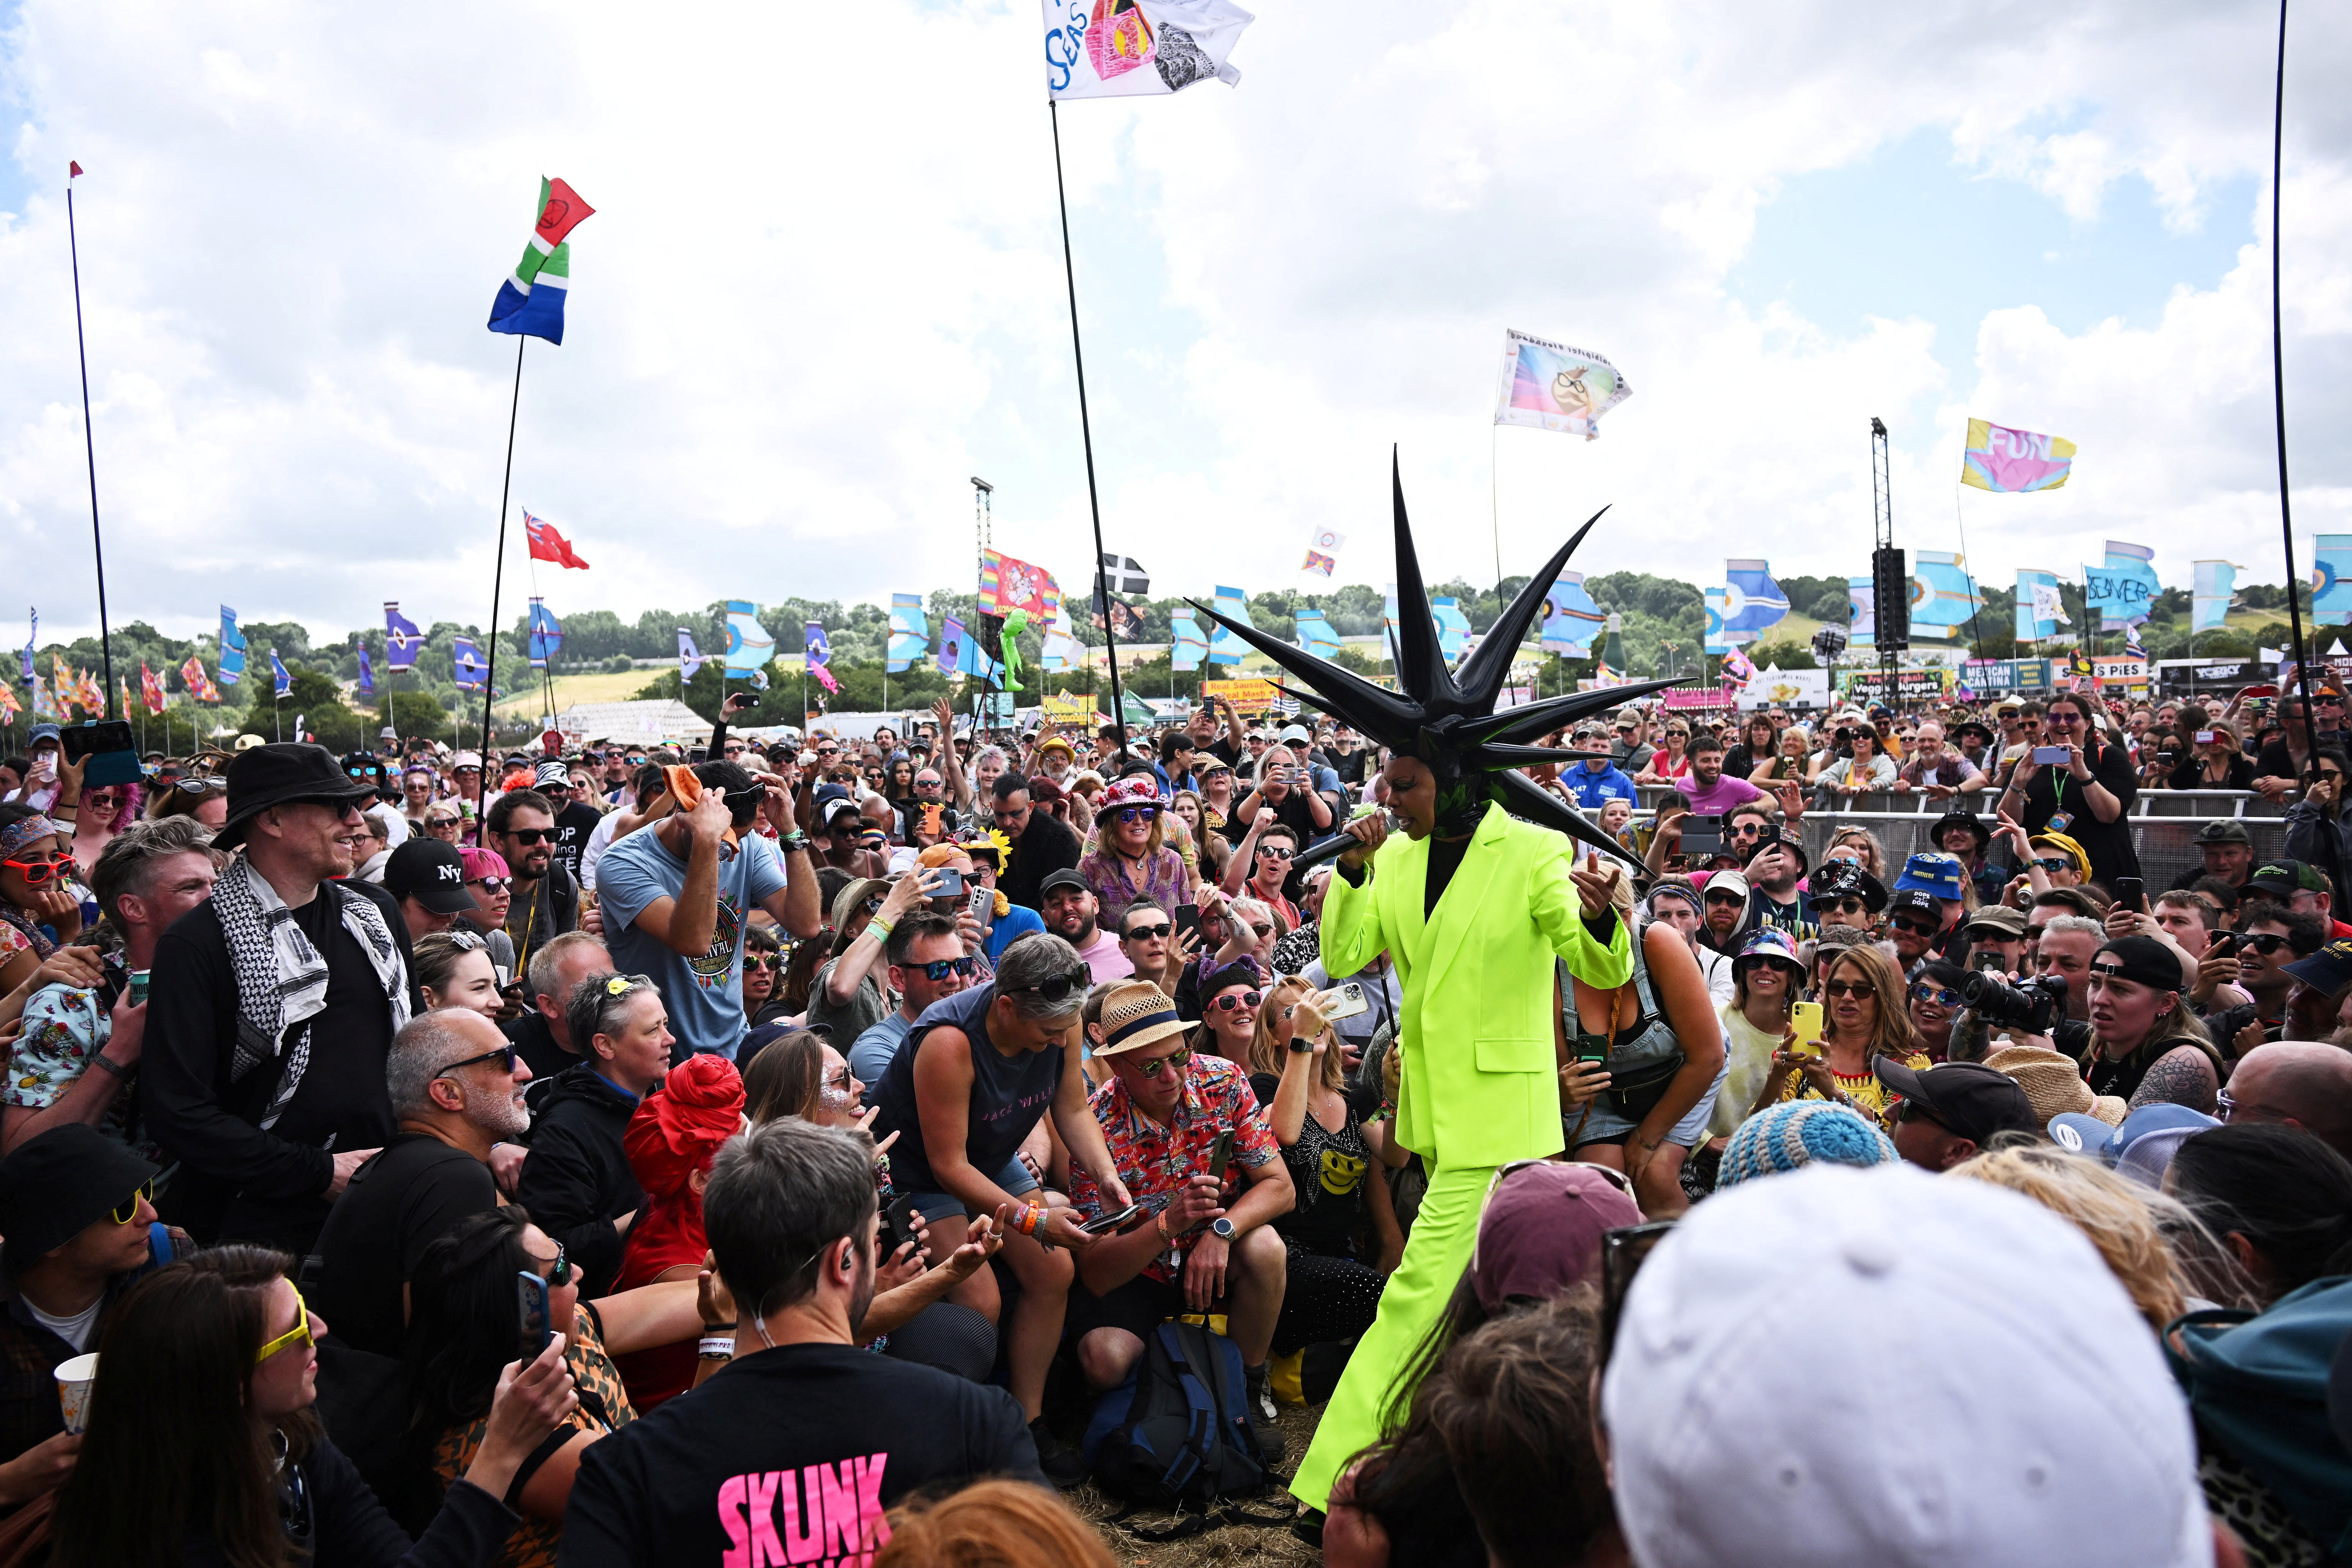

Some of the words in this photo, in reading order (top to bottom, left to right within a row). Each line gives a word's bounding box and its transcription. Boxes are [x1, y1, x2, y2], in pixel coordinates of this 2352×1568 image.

[1988, 427, 2054, 462] FUN
[2088, 574, 2148, 603] BEAVER
[1967, 665, 2010, 678] MEXICAN
[2196, 665, 2241, 677] YORKY
[1968, 676, 2010, 688] CANTINA
[1599, 788, 1617, 797] SECURITY
[1913, 869, 1935, 879] BROTHERS
[1912, 899, 1929, 908] DOPE
[2321, 945, 2344, 959] belter
[697, 964, 720, 974] PERFORMING
[719, 961, 729, 970] ARTS
[700, 955, 728, 967] CONTEMPORARY
[981, 1102, 1013, 1121] JACK
[1169, 1133, 1185, 1149] MAUI
[1245, 1130, 1261, 1151] MAUI
[1170, 1146, 1185, 1157] Aloha
[1150, 1174, 1167, 1193] MAUI
[718, 1452, 893, 1568] SKUNK
